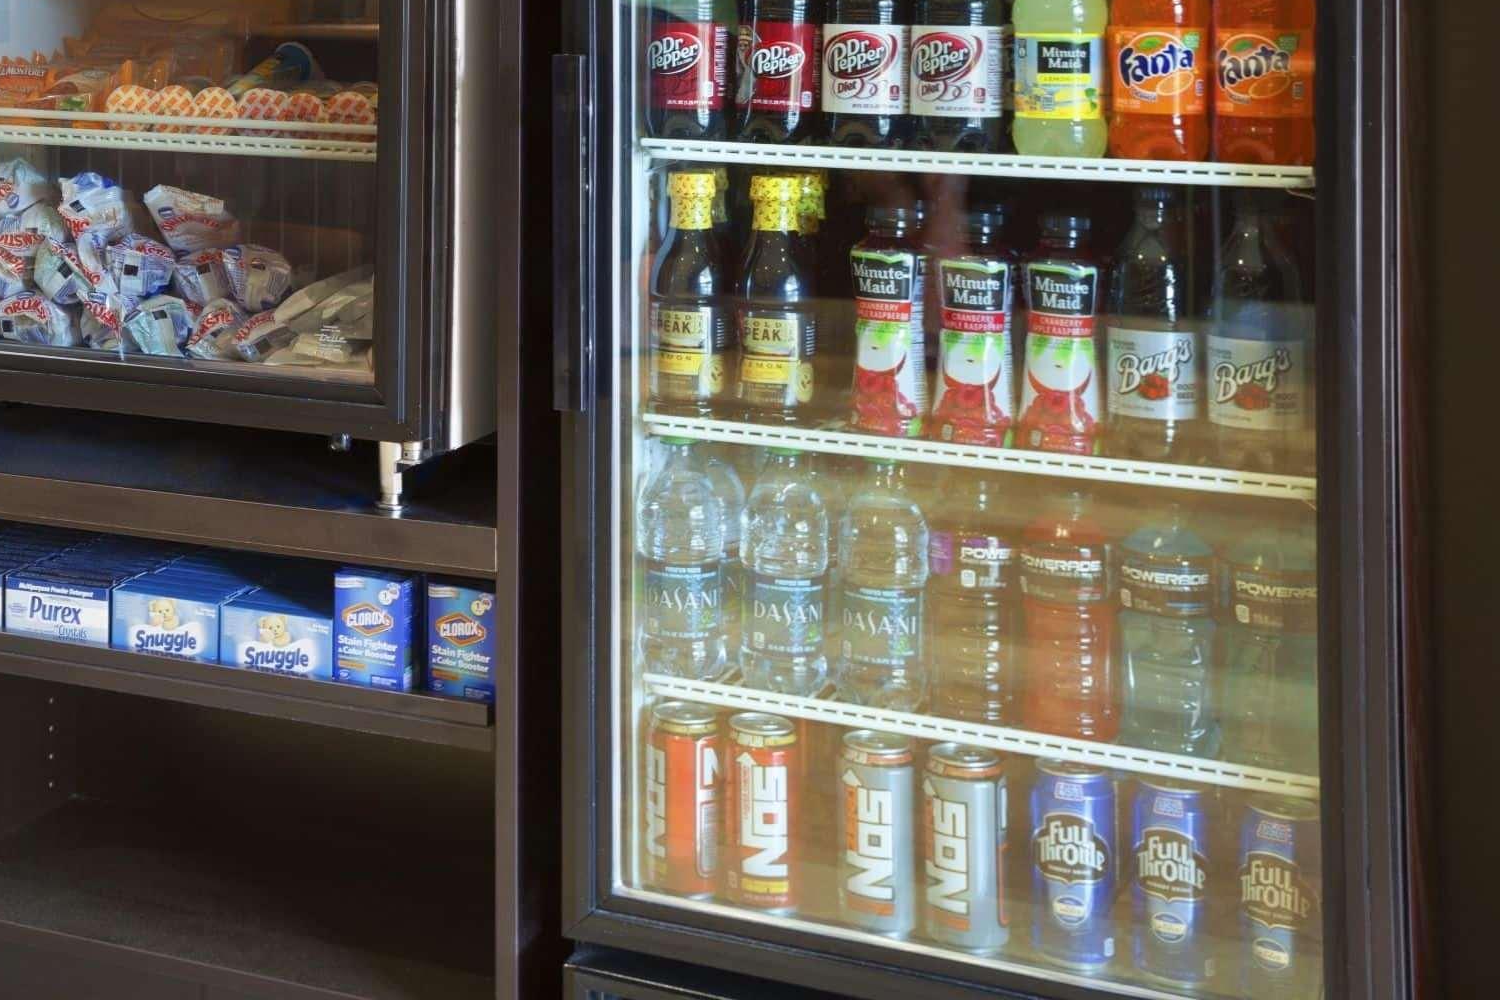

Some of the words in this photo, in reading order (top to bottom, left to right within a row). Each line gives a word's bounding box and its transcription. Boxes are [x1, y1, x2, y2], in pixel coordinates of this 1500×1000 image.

[651, 40, 699, 70] Pepper
[661, 37, 684, 53] Dr
[771, 45, 790, 60] Dr
[847, 38, 870, 53] Dr
[930, 40, 953, 54] Dr
[1041, 47, 1087, 59] Minute
[755, 49, 803, 75] Pepper
[833, 42, 885, 73] Pepper
[918, 43, 969, 74] Pepper
[1047, 57, 1083, 69] Maid
[1117, 43, 1195, 88] Fanta
[1216, 46, 1291, 89] Fanta
[837, 81, 857, 94] Diet
[853, 262, 904, 280] Minute
[946, 273, 1000, 291] Minute
[859, 278, 898, 295] Maid
[953, 289, 994, 306] Maid
[1034, 276, 1089, 295] Minute
[1041, 293, 1083, 310] Maid
[1117, 338, 1192, 394] Barq's
[1213, 349, 1292, 404] Barq's
[29, 595, 82, 625] Purex
[753, 599, 823, 626] DASANI
[135, 629, 197, 652] Snuggle
[338, 634, 363, 648] Stain
[363, 637, 398, 653] Fighter
[243, 646, 310, 670] Snuggle
[364, 649, 397, 662] Booster
[431, 645, 456, 658] Stain
[456, 648, 492, 664] Fighter
[458, 661, 490, 674] Booster
[741, 760, 788, 877] NOS
[846, 786, 895, 901] NOS
[1049, 819, 1090, 846] Full
[925, 792, 969, 916] NOS
[1037, 835, 1106, 872] Throttle
[1147, 835, 1191, 861] Full
[1137, 851, 1206, 889] Throttle
[1250, 860, 1293, 890] Full
